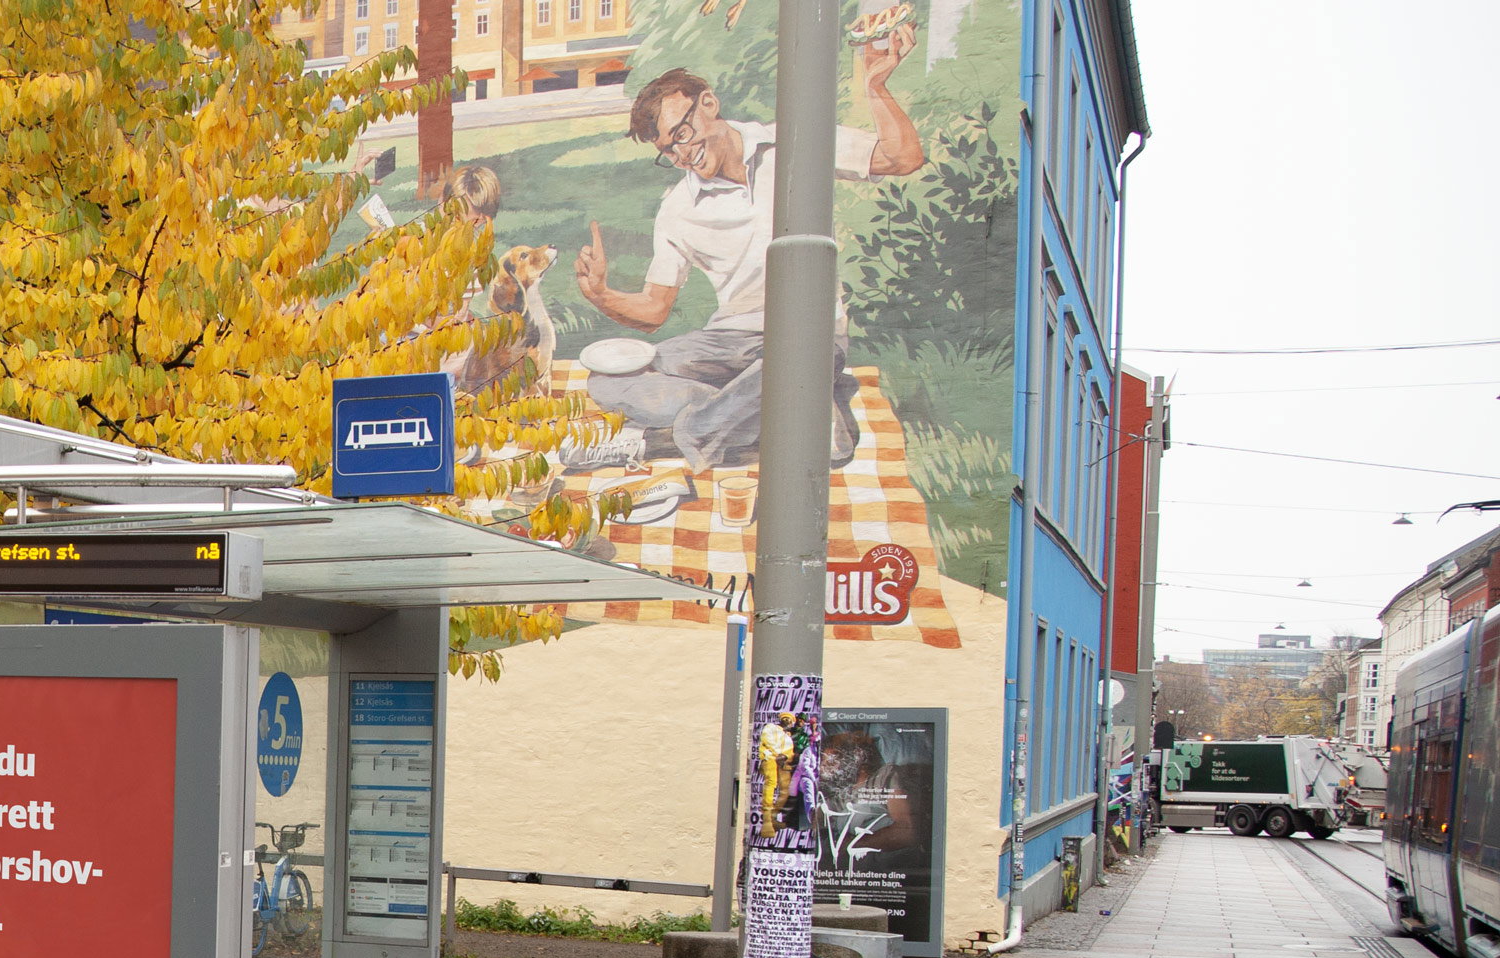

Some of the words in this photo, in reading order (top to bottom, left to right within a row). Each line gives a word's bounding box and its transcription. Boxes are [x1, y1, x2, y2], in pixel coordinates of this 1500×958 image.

[56, 543, 80, 560] st.
[196, 543, 220, 560] nå
[871, 546, 902, 559] SIDEN
[903, 554, 913, 579] 1951
[356, 682, 365, 690] 11
[355, 698, 364, 706] 12
[355, 714, 364, 722] 18
[838, 712, 857, 720] Clear
[858, 712, 887, 720] Channel
[271, 695, 290, 750] 5
[285, 731, 301, 749] min
[754, 867, 808, 878] YOUSSOU
[851, 870, 887, 878] håndtere
[752, 877, 807, 886] FATOUMATA
